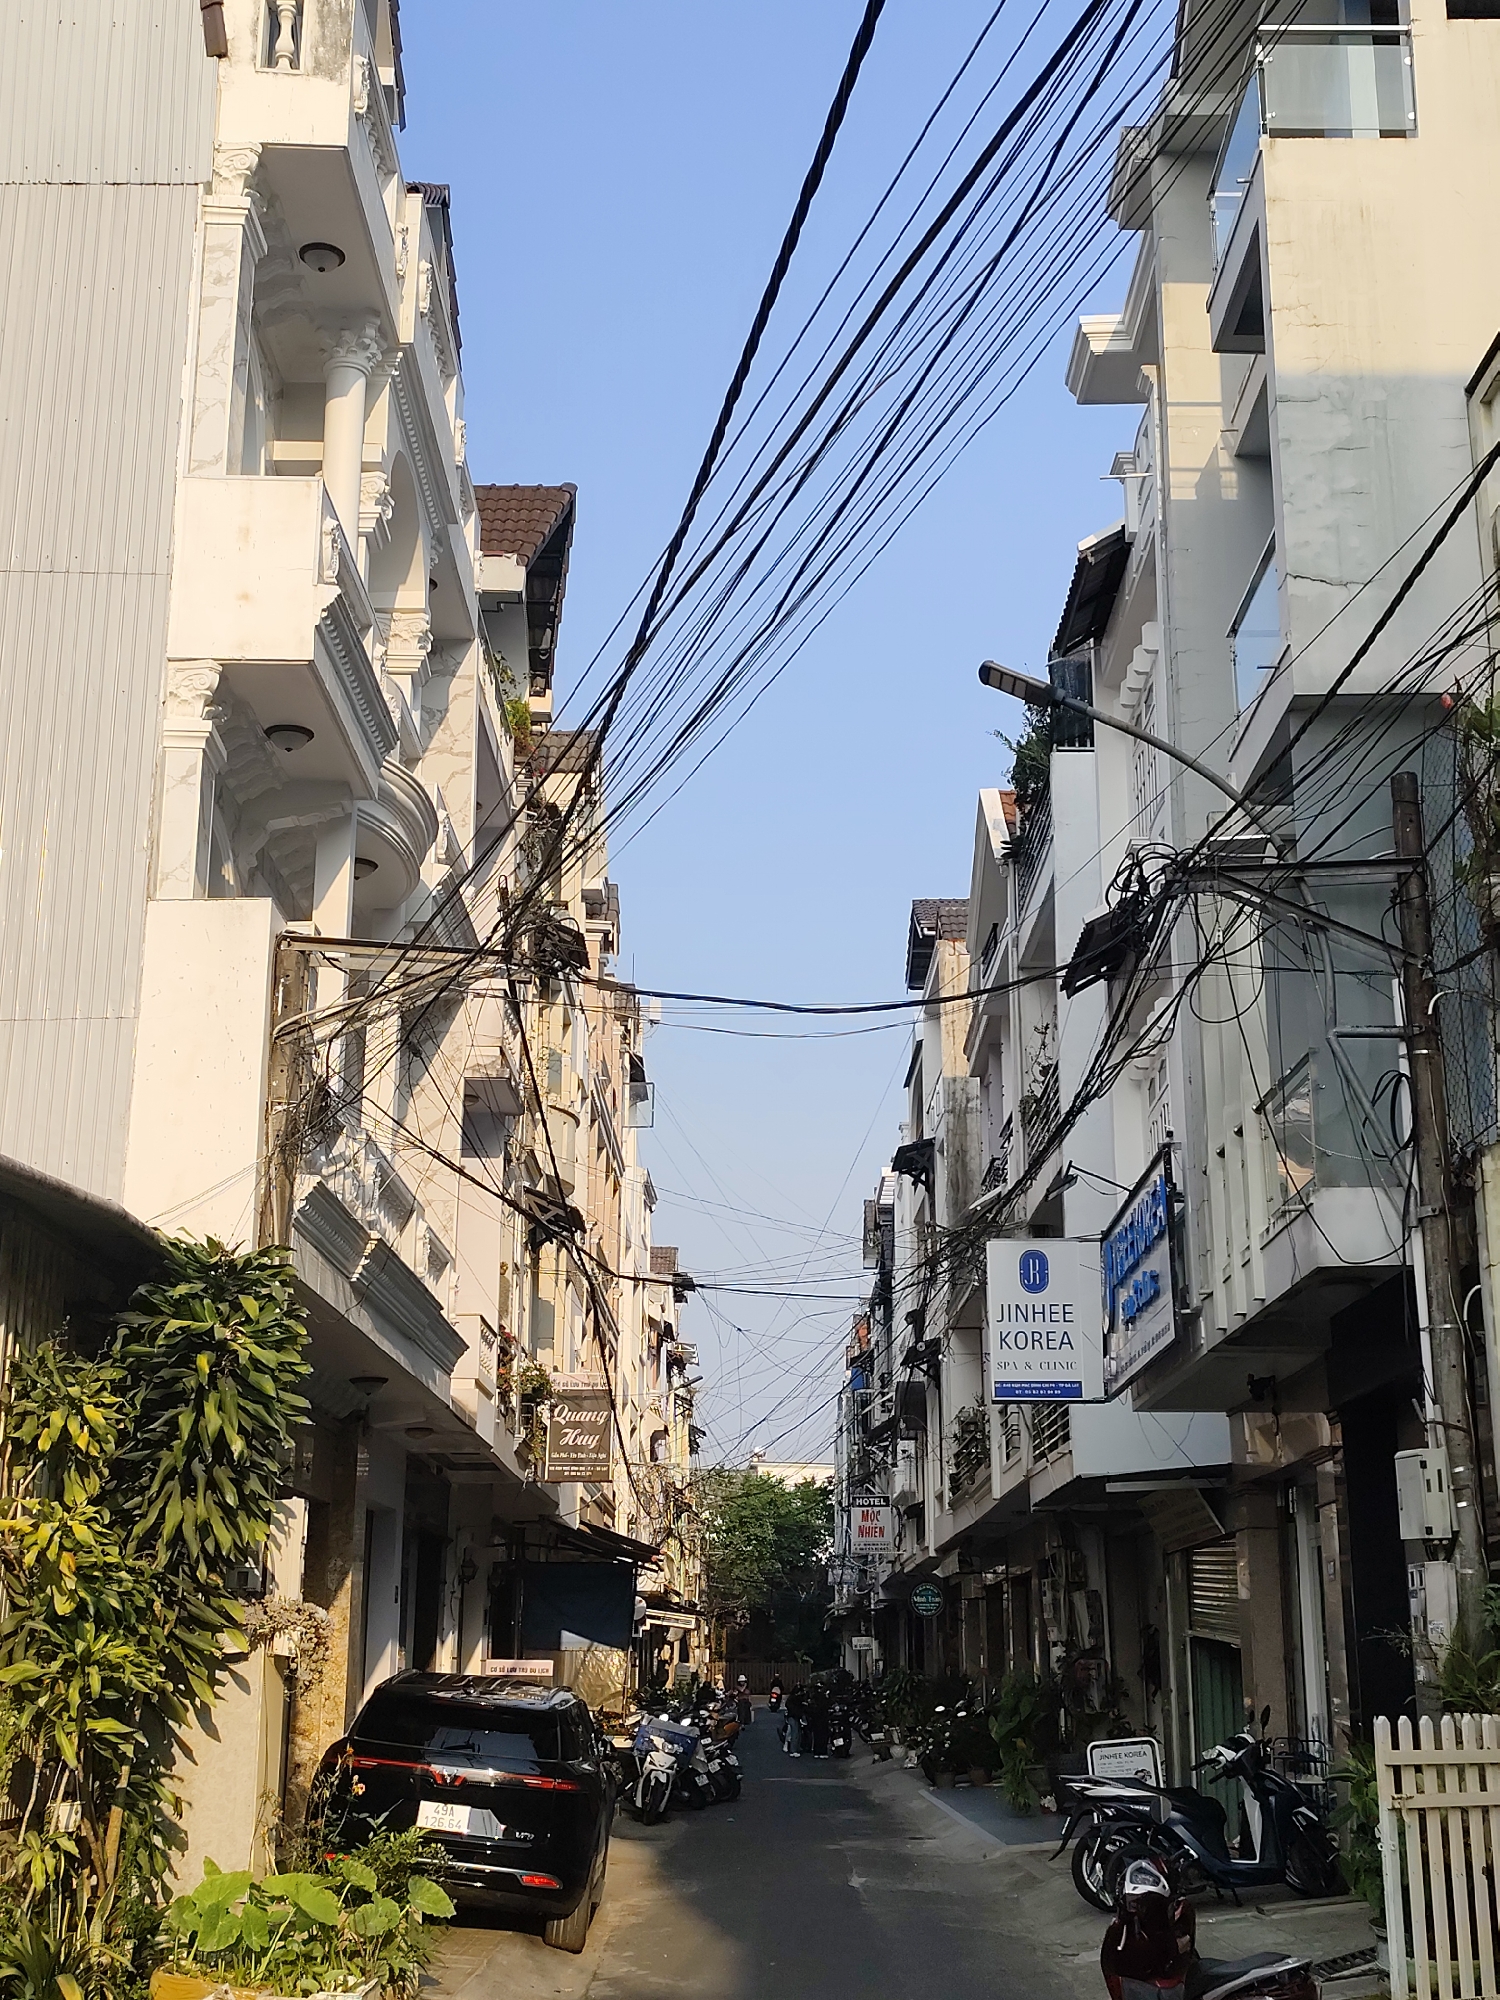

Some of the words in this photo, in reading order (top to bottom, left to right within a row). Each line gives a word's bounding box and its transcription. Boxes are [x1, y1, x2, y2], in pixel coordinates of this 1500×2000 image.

[996, 1303, 1074, 1323] JINHEE
[999, 1330, 1075, 1350] KOREA
[996, 1361, 1018, 1371] SPA
[1024, 1361, 1033, 1371] &
[1039, 1361, 1077, 1371] CLINIC
[552, 1404, 608, 1425] Quang
[559, 1429, 601, 1449] Huy
[856, 1498, 886, 1506] HOTEL
[861, 1507, 880, 1524] MỘC
[857, 1523, 885, 1538] NHIÊN
[1099, 1752, 1123, 1760] JINHEE
[1123, 1750, 1147, 1758] KOREA
[433, 1804, 455, 1817] 49A
[424, 1815, 462, 1829] 126.64
